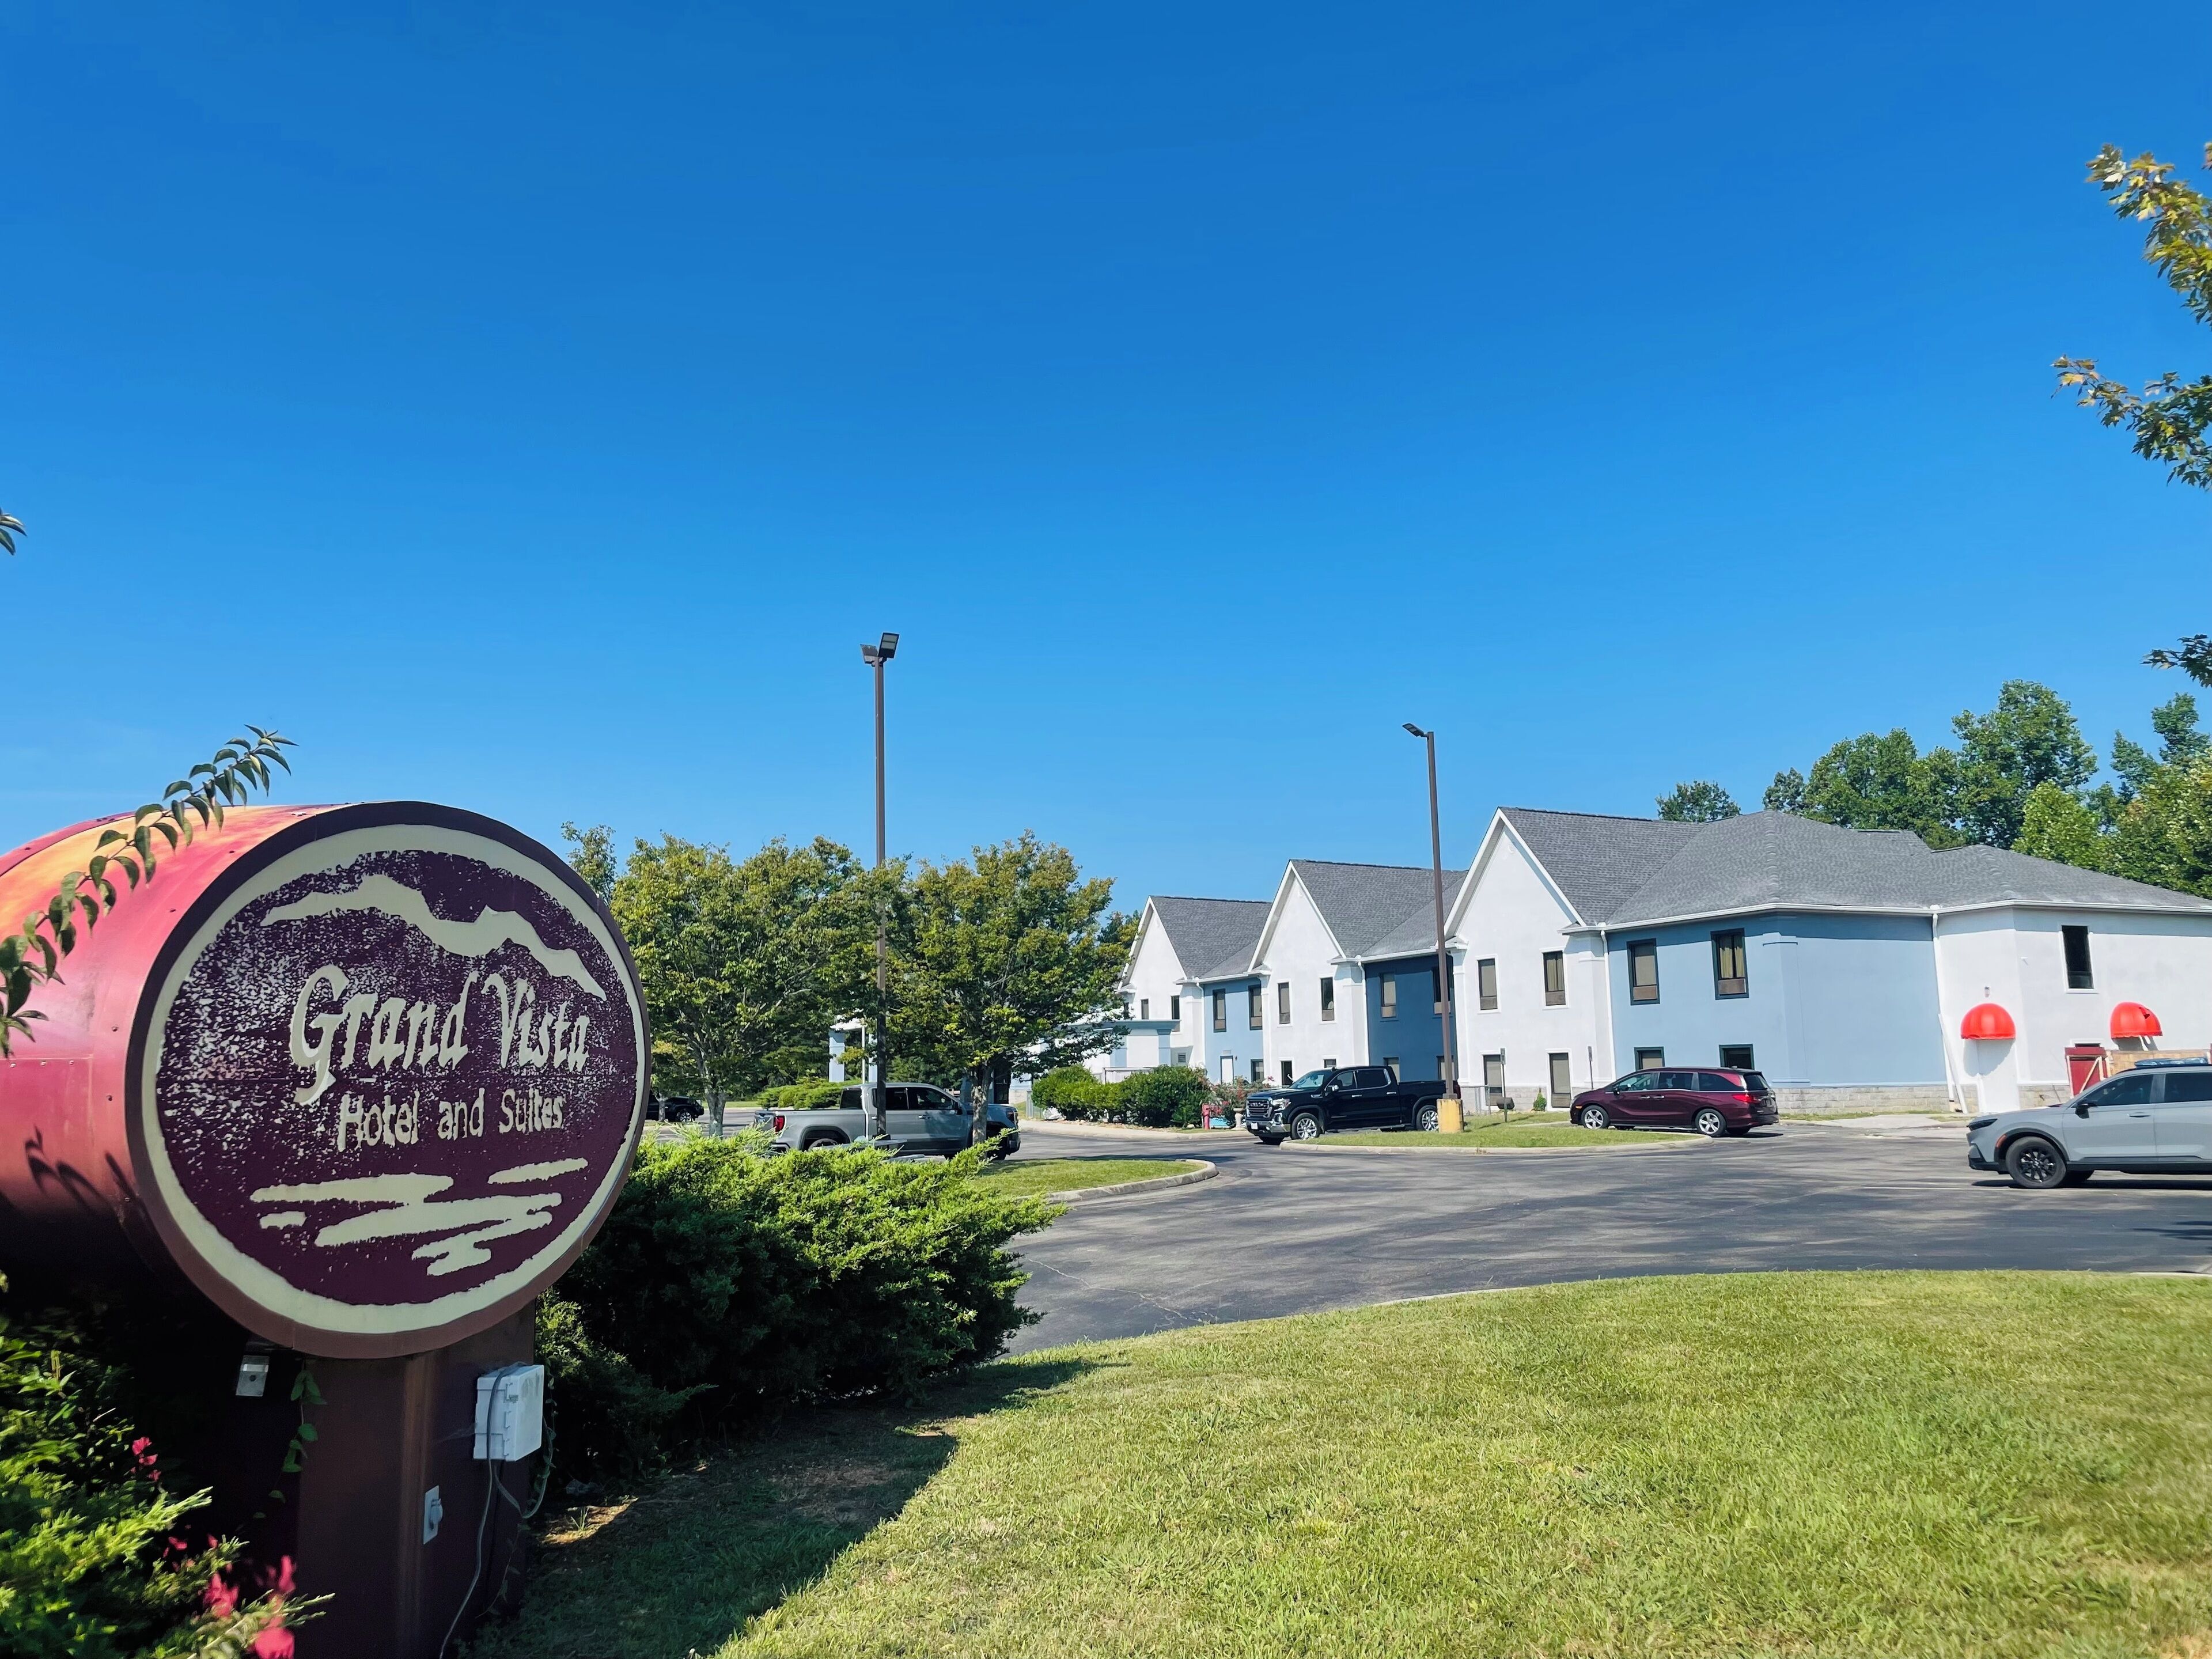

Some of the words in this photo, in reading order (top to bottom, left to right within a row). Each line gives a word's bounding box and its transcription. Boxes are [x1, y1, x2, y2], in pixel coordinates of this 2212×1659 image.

[289, 964, 479, 1105] Grand
[482, 972, 590, 1072] Vista
[337, 1089, 420, 1152] Hotel
[437, 1088, 484, 1140] and
[499, 1088, 566, 1133] Suites
